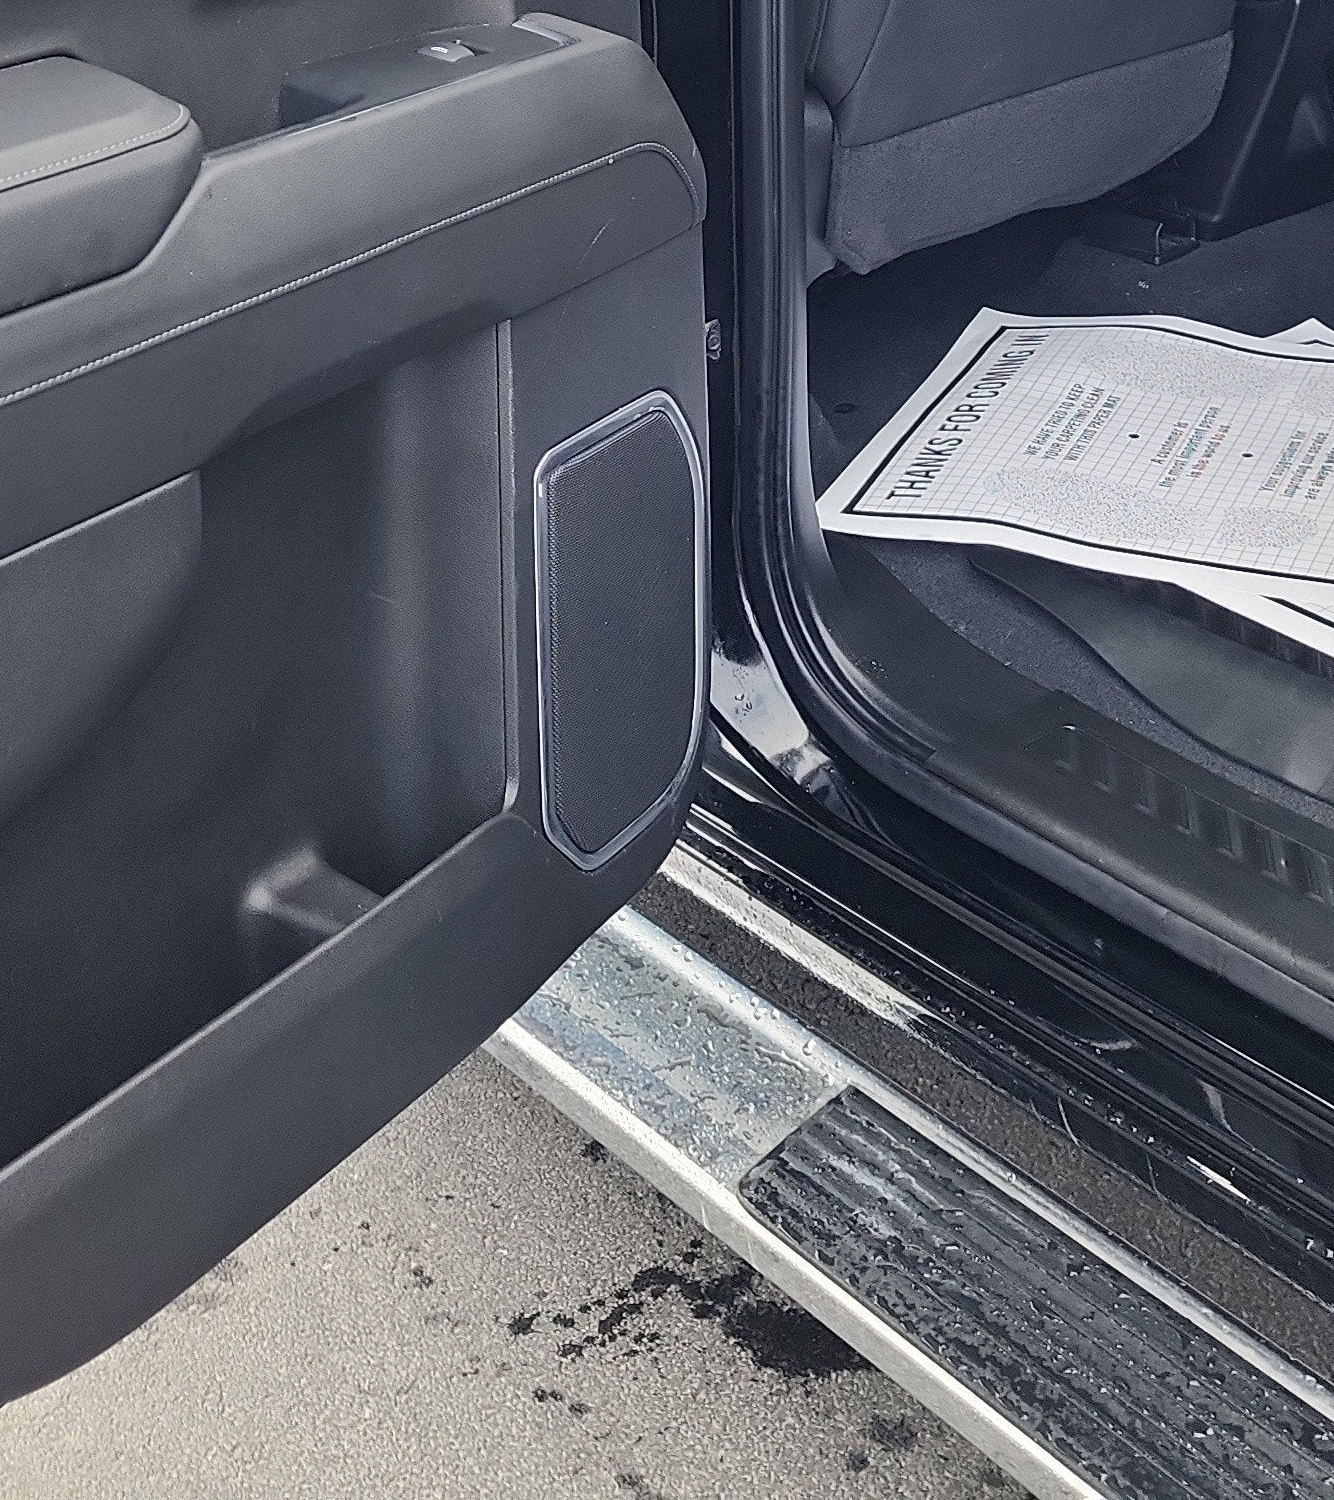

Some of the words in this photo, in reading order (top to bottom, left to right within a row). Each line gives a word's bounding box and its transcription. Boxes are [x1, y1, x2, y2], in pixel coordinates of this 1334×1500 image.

[1066, 383, 1086, 401] KEEP
[1058, 401, 1075, 410] TO
[886, 436, 964, 500] THANKS
[937, 403, 990, 432] FOR
[966, 349, 1036, 400] COMING
[1010, 334, 1050, 347] IN
[1041, 442, 1066, 460] YOUR
[1081, 386, 1105, 409] CLEAN
[1044, 410, 1068, 428] TRIED
[1063, 442, 1086, 461] WITH
[1076, 428, 1097, 444] THIS
[1087, 409, 1112, 429] PAPER
[1102, 394, 1121, 410] MAT
[1199, 407, 1220, 428] person
[1032, 428, 1054, 446] HAVE
[1157, 427, 1184, 459] customer
[1173, 421, 1188, 429] is
[1175, 428, 1209, 459] important
[1023, 444, 1041, 456] WE
[1168, 459, 1188, 477] most
[1258, 476, 1280, 492] Your
[1290, 430, 1307, 441] for
[1310, 464, 1334, 487] always
[1305, 487, 1321, 501] are
